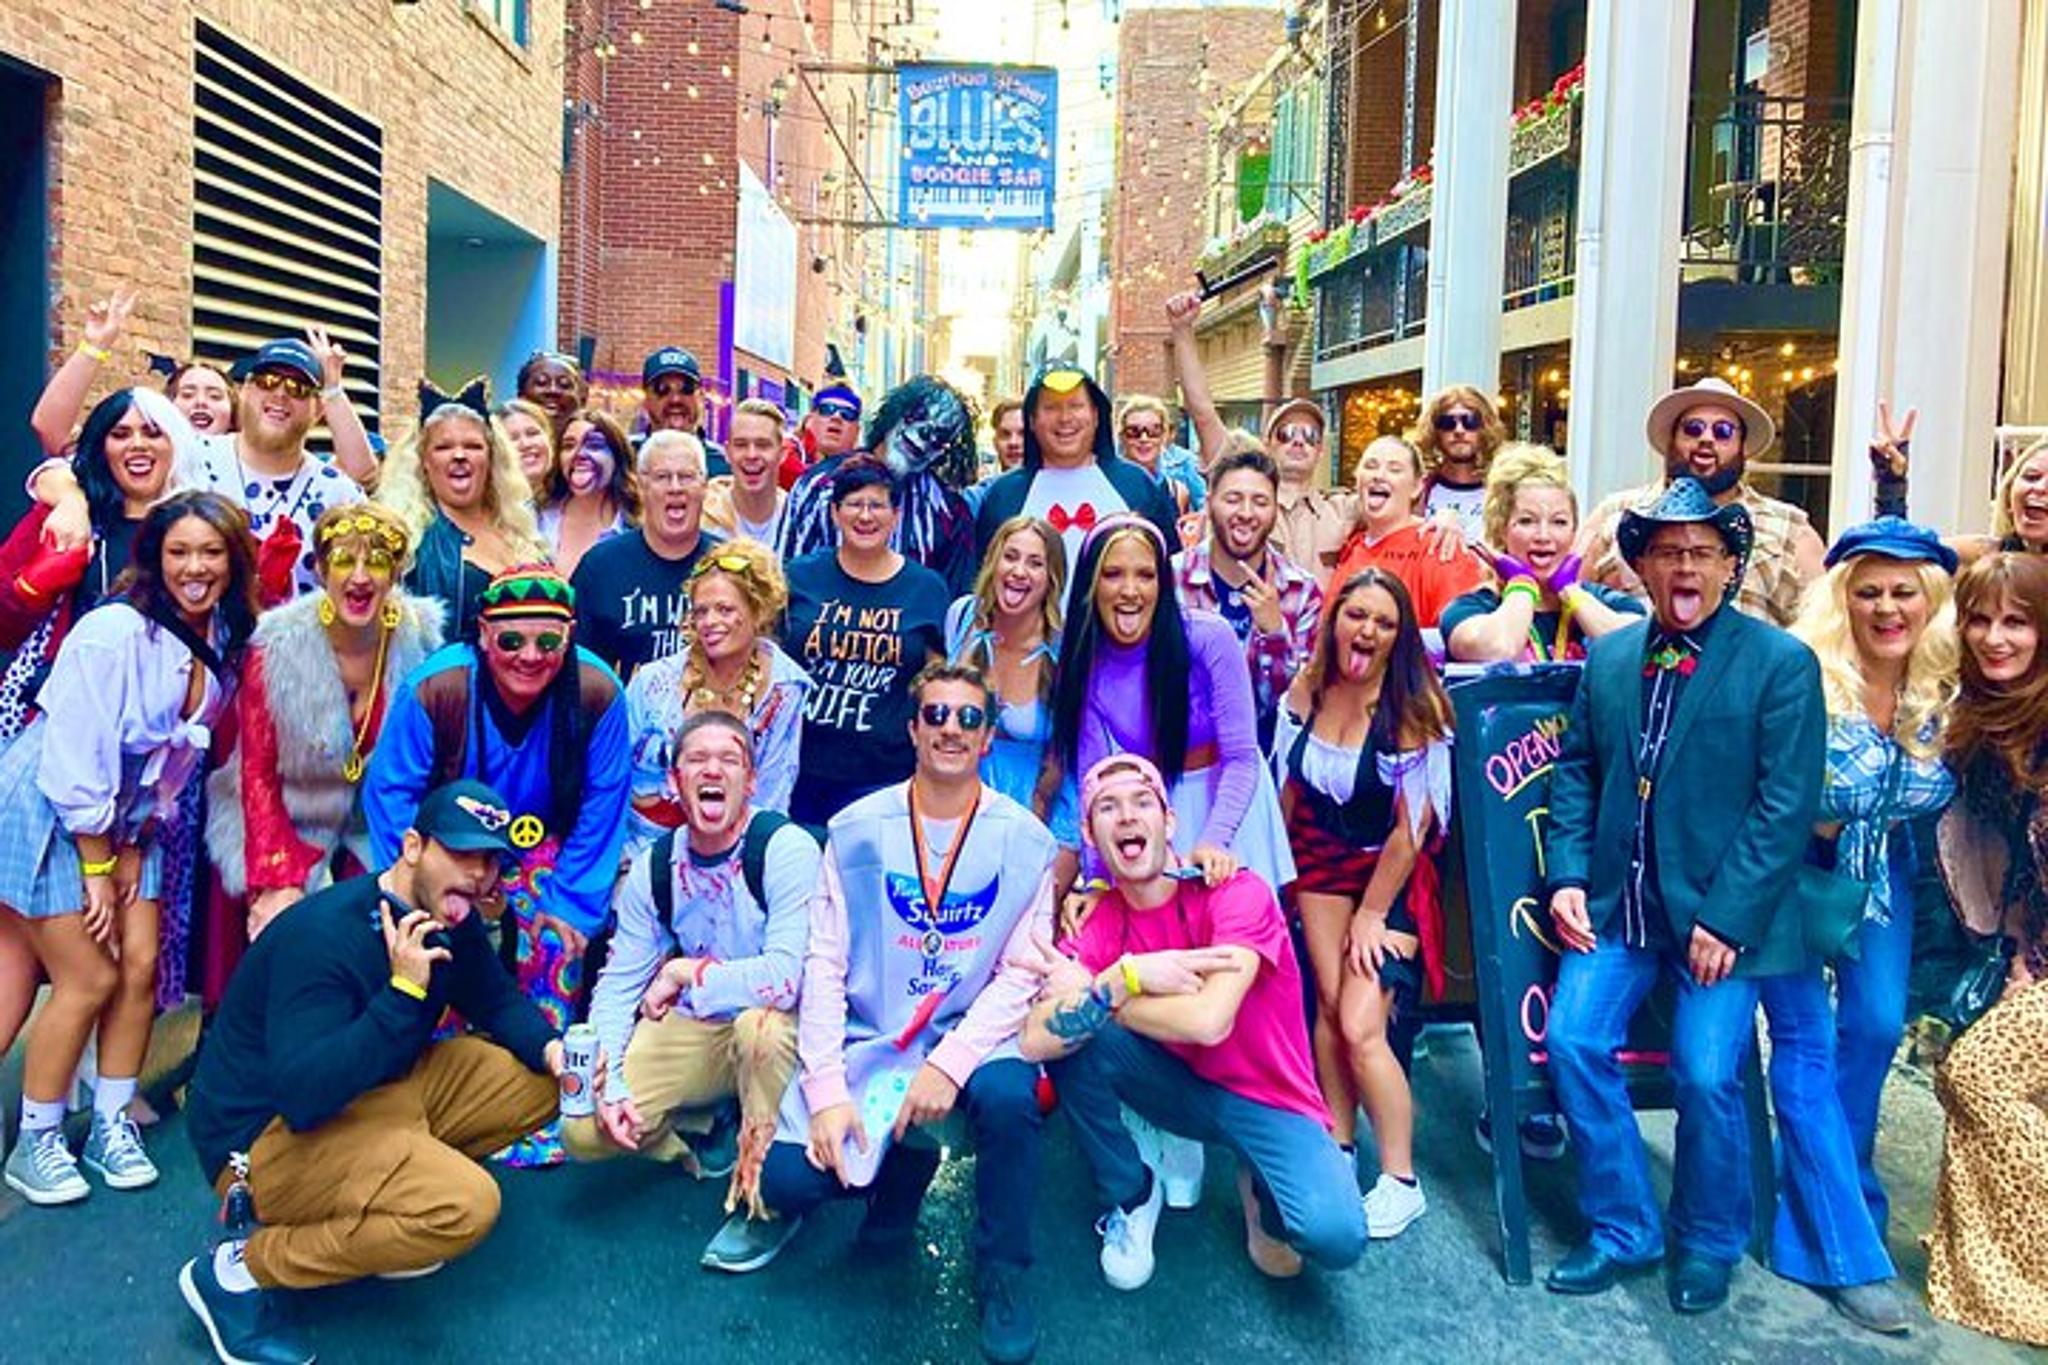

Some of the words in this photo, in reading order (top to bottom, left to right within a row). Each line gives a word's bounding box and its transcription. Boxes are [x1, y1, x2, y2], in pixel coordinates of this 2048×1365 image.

[909, 90, 1043, 154] BLUES
[911, 165, 992, 186] BOOGIE
[998, 167, 1043, 187] BAR
[621, 587, 657, 629] I'M
[813, 599, 852, 626] I'M
[859, 608, 902, 632] NOT
[804, 625, 822, 658] A
[830, 630, 903, 667] WITCH
[844, 661, 897, 693] YOUR
[802, 682, 879, 732] WIFE
[1486, 729, 1561, 793] OPEN
